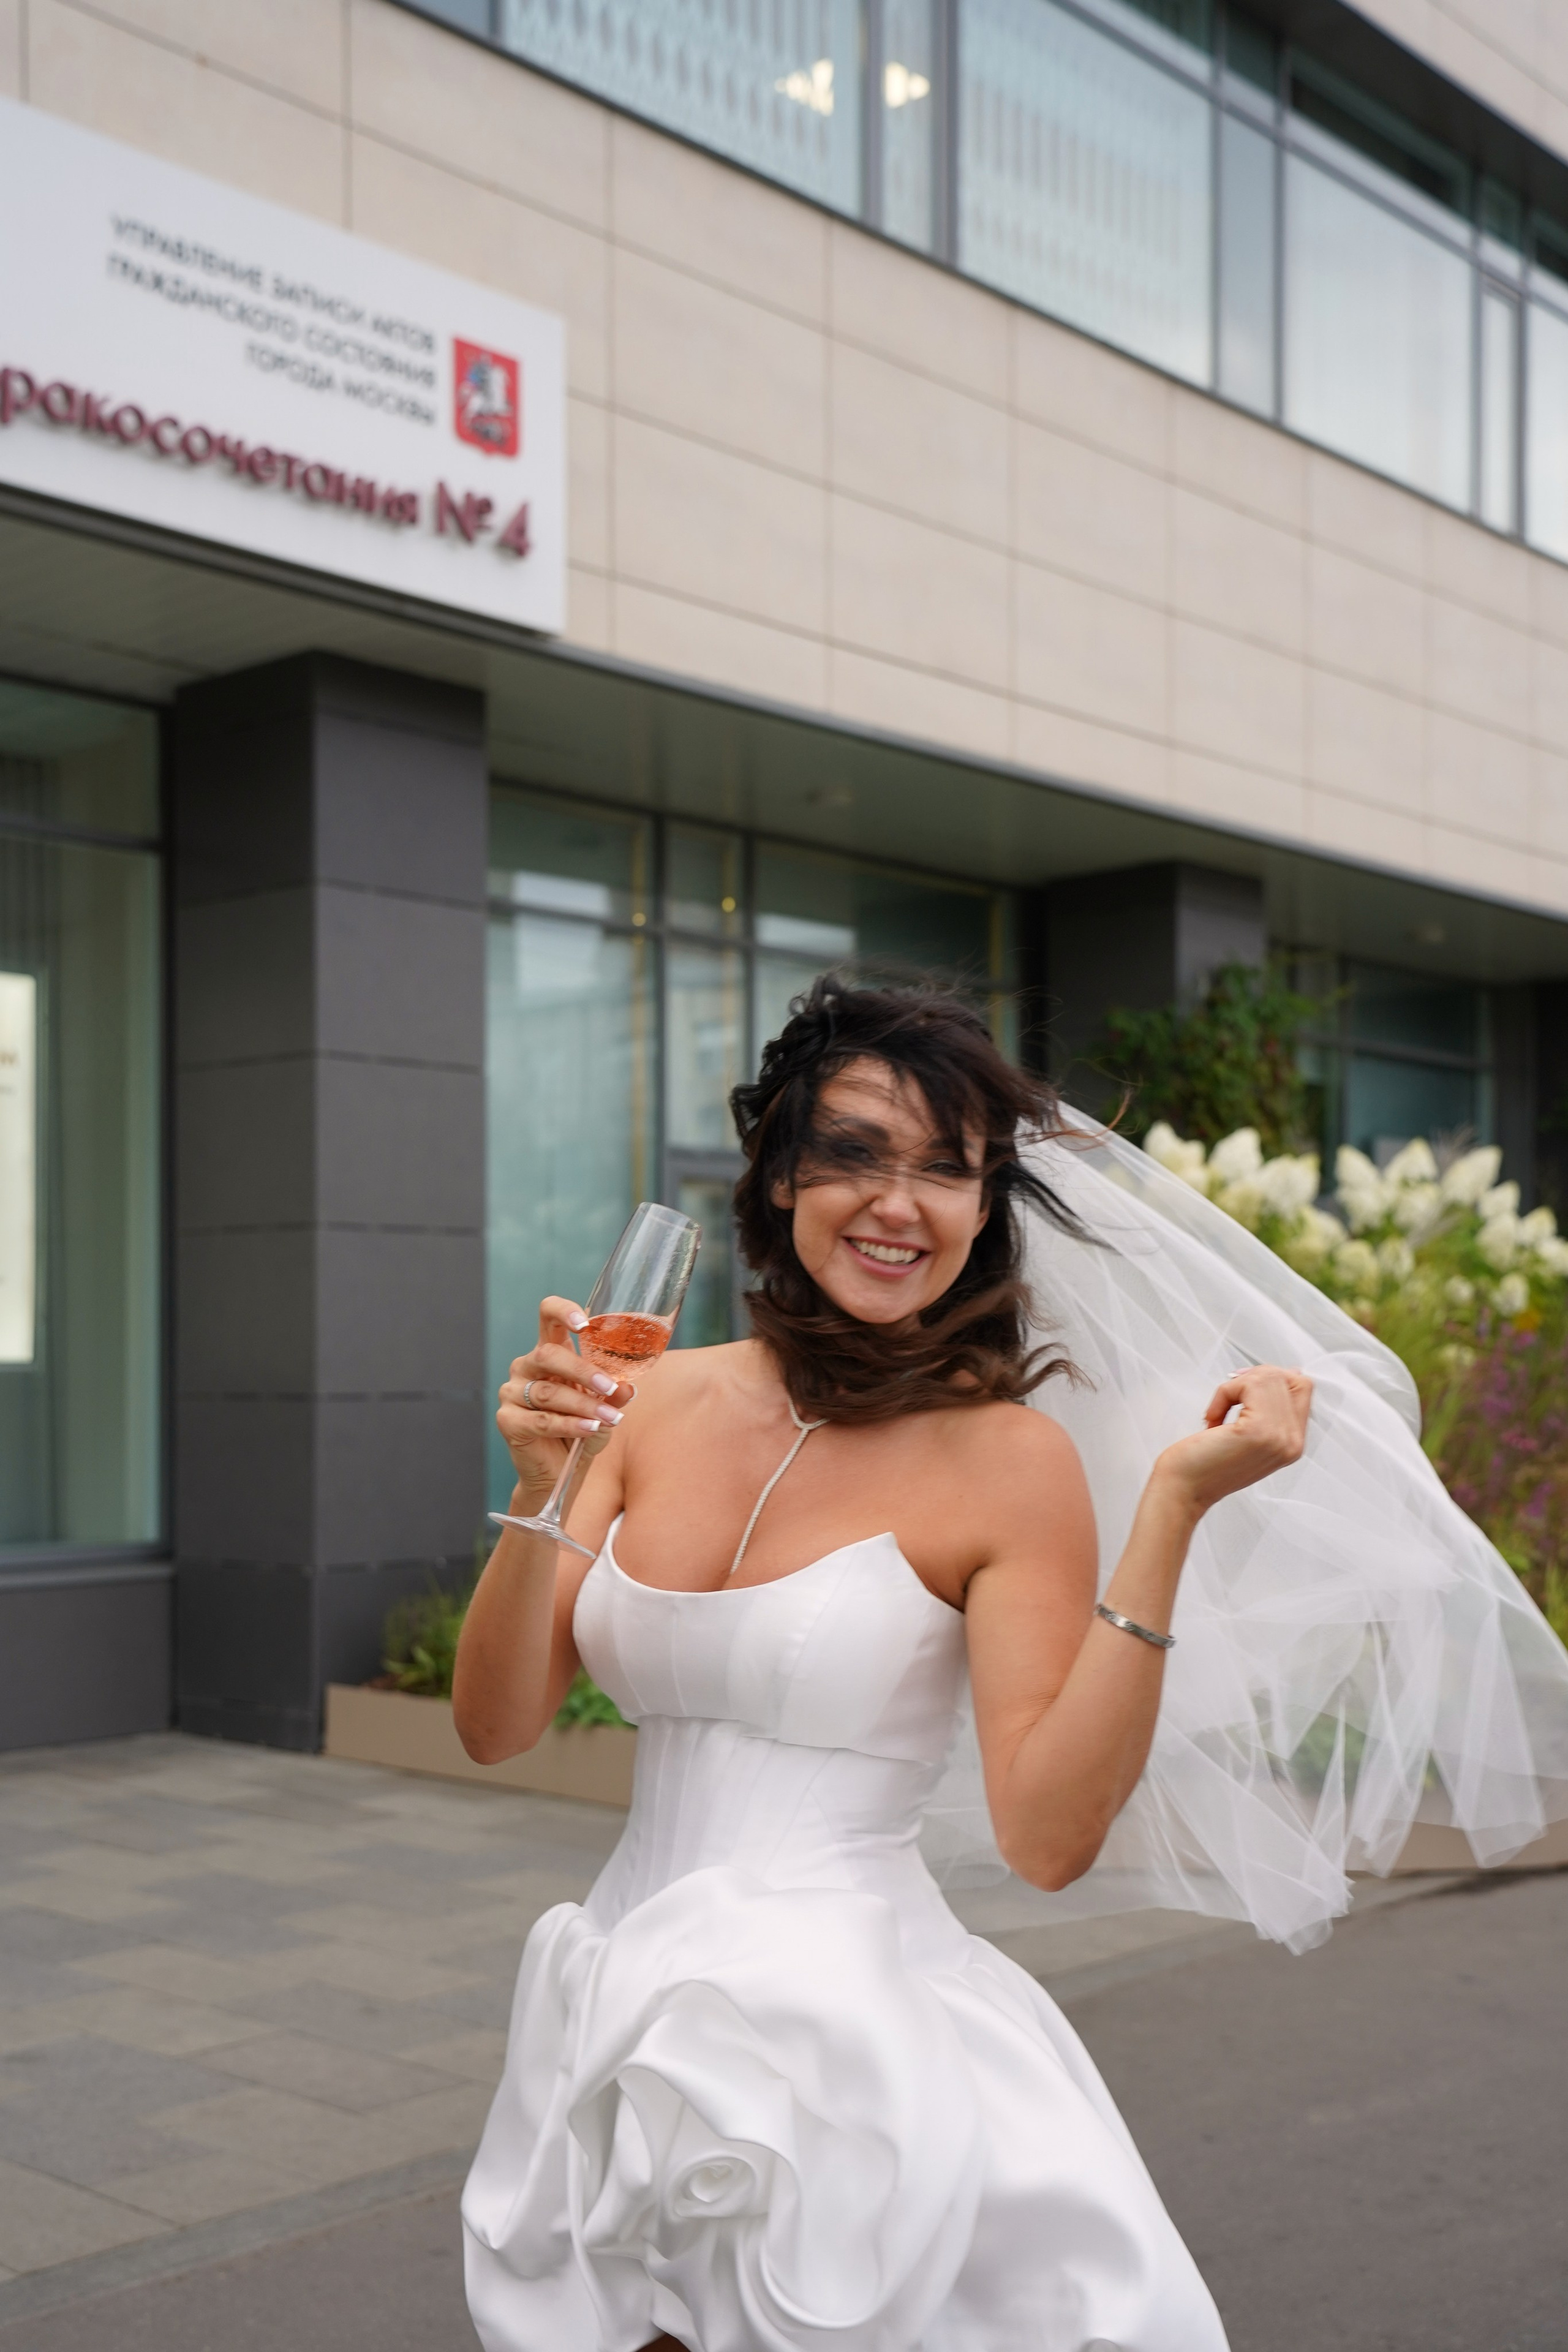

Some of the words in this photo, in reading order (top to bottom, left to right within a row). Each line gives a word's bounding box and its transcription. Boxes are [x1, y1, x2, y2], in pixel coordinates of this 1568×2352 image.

[110, 213, 263, 296] УПРАВЛЕНИЕ
[105, 250, 300, 344] ГРАЖДАНСКОГО
[304, 322, 437, 390] СОСТОЯНИЯ
[245, 341, 334, 394] ГОРОДА
[342, 377, 437, 428] МОСКВЫ
